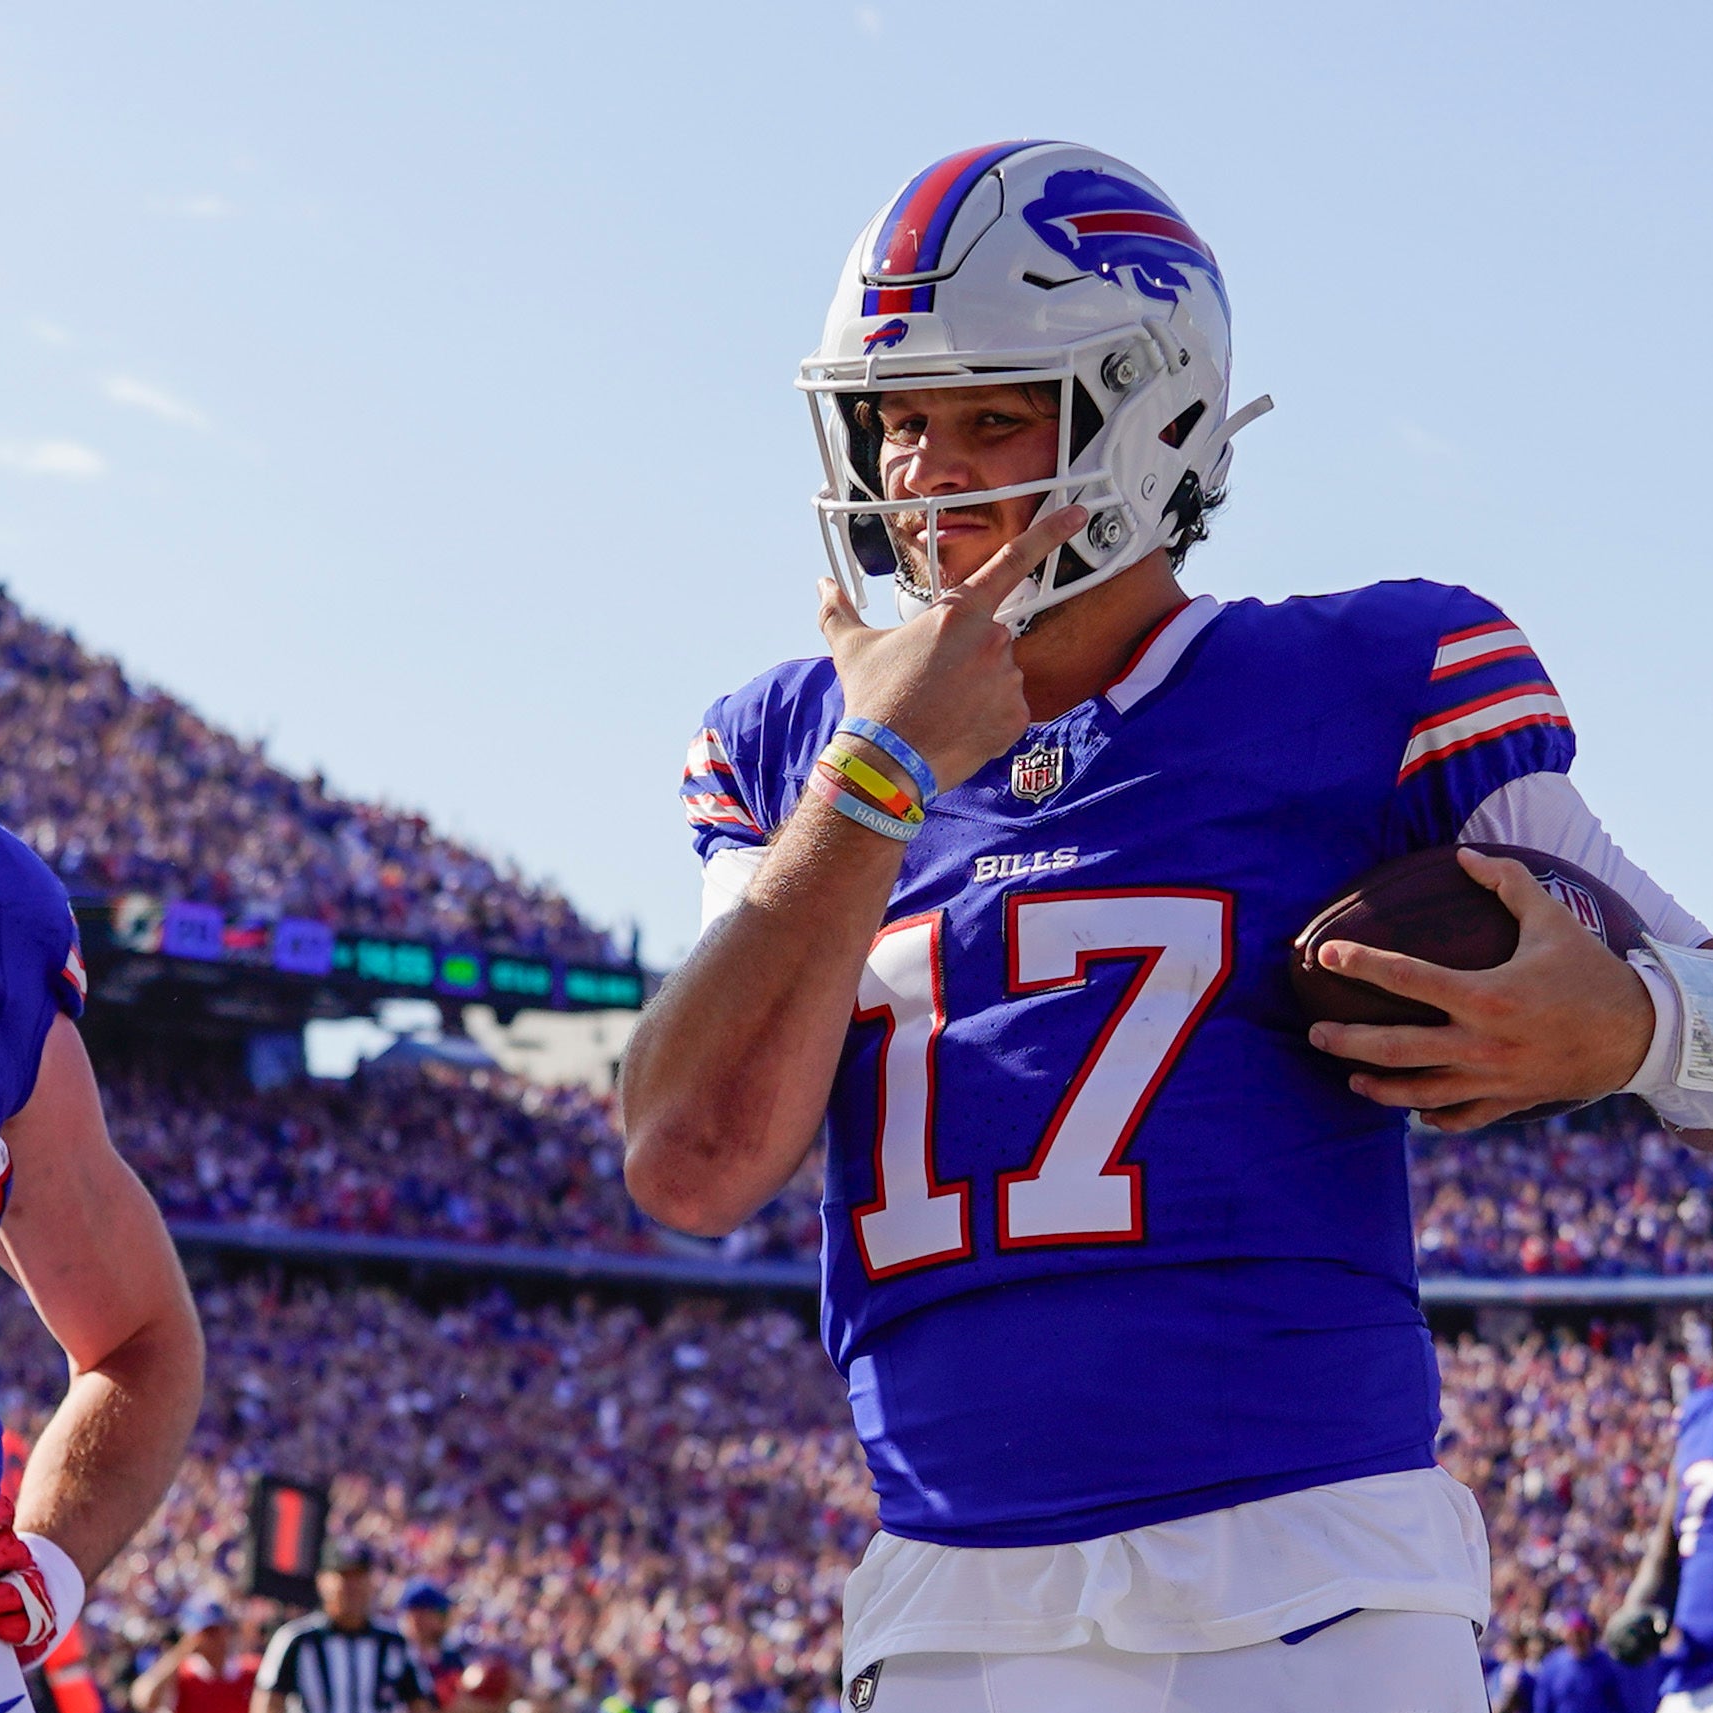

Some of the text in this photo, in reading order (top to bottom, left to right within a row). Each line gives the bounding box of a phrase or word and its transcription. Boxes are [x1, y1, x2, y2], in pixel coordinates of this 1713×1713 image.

[1021, 767, 1054, 791] NFL
[973, 846, 1079, 883] BILLS
[851, 886, 1235, 1281] 17
